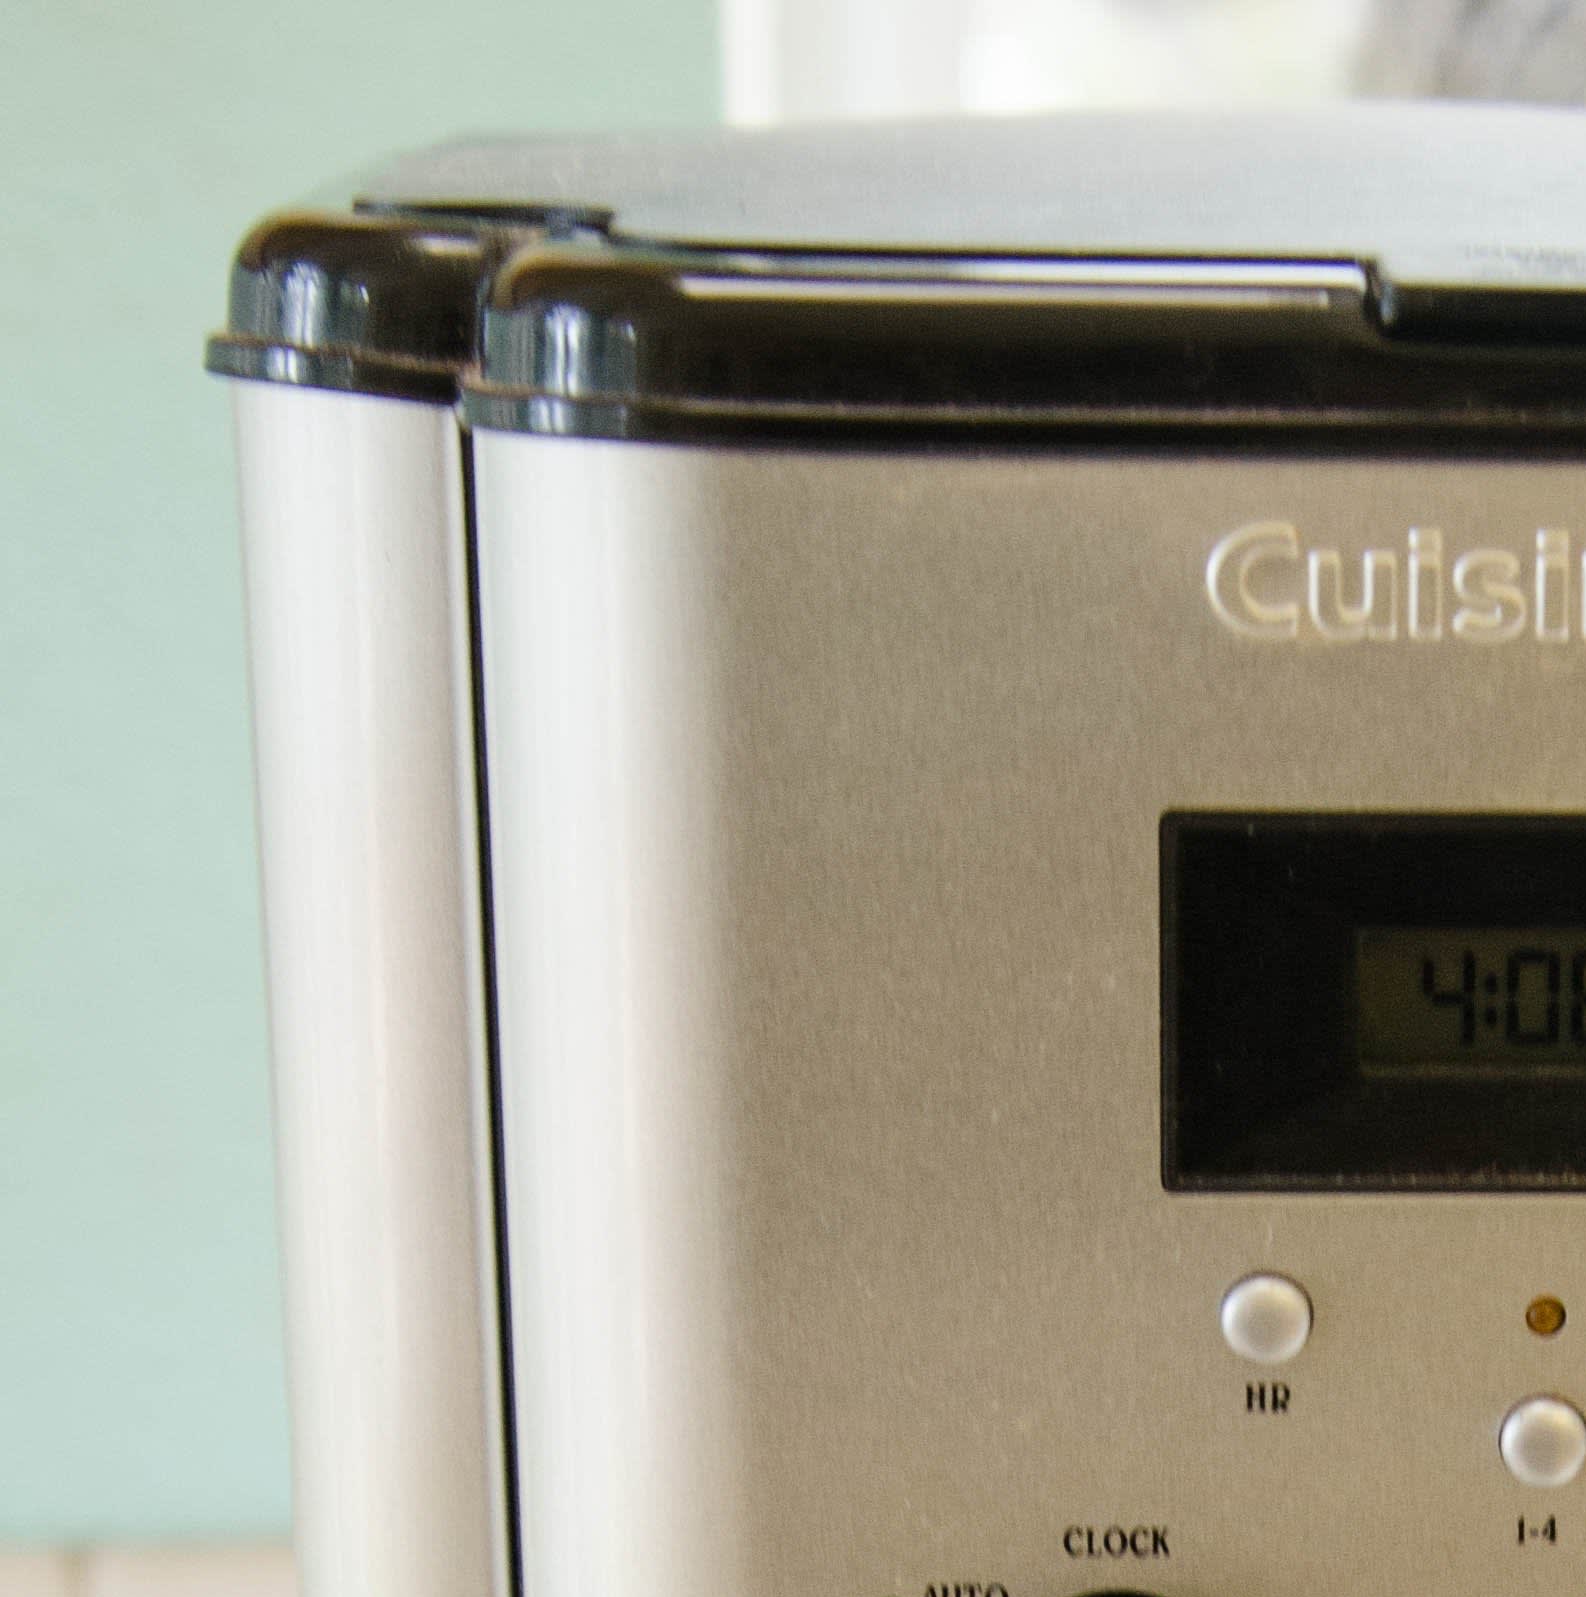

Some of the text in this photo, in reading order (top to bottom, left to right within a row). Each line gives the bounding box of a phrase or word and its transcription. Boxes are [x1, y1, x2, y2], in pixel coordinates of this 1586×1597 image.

[1245, 1382, 1290, 1414] HR
[1062, 1526, 1171, 1559] CLOCK
[1516, 1515, 1558, 1546] 1-4
